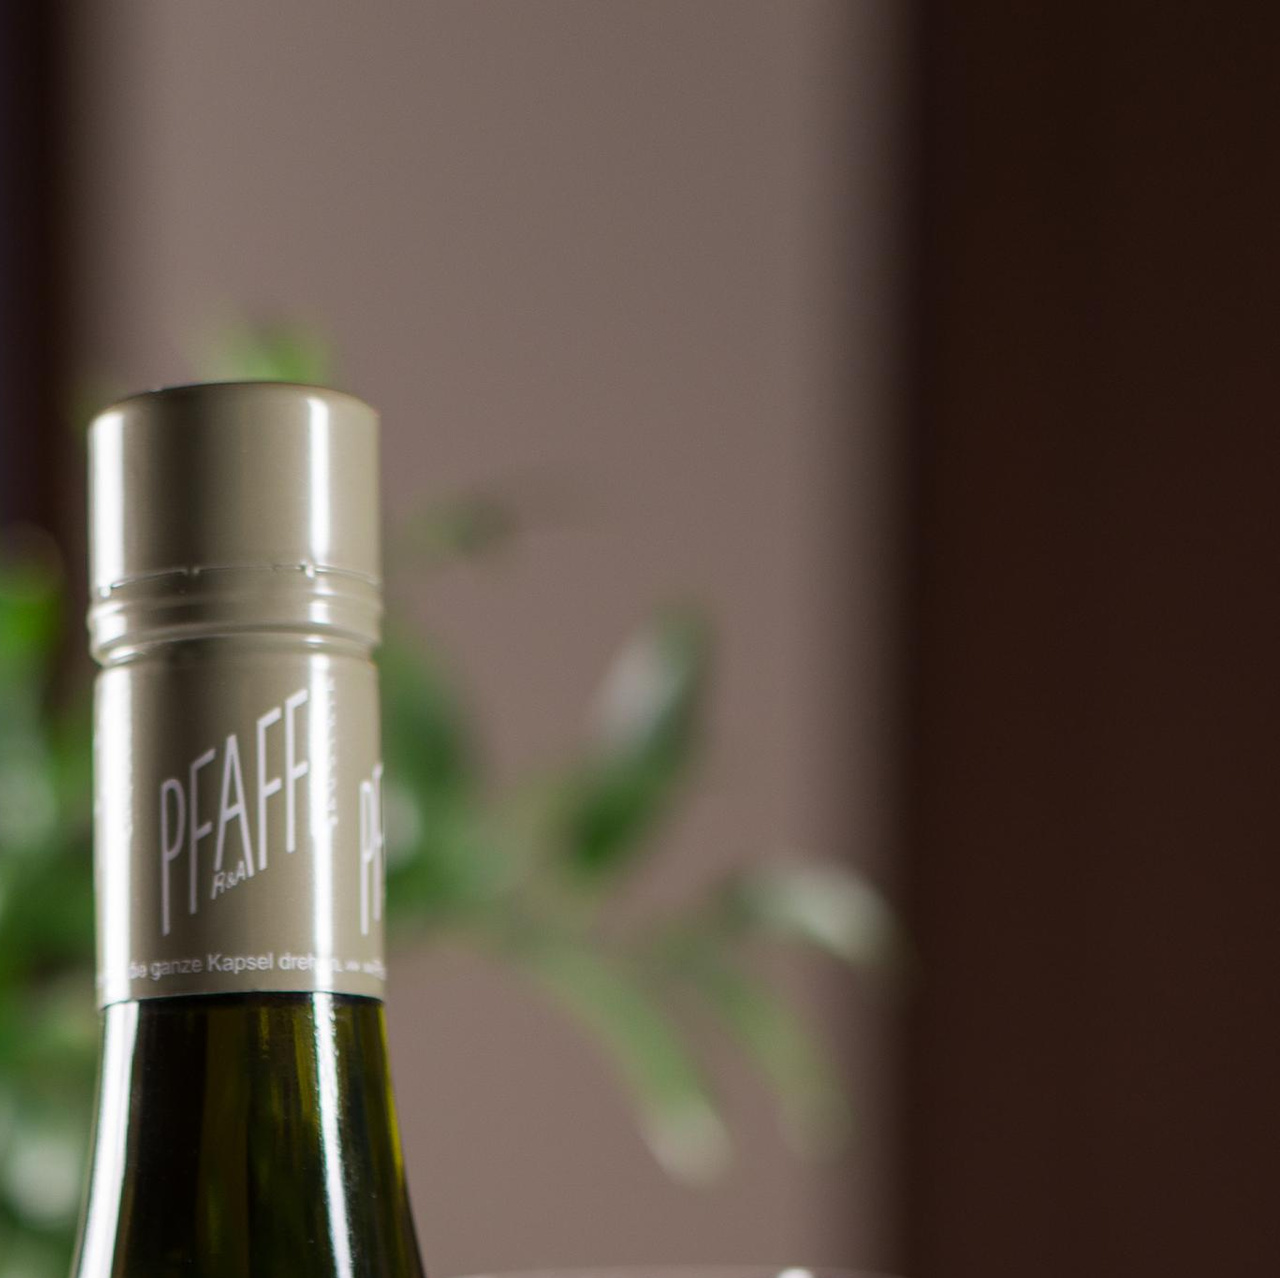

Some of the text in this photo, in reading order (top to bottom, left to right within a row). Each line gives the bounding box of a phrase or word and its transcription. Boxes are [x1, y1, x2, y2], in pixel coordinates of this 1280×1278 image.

[160, 682, 337, 936] PFAFF
[150, 958, 203, 981] ganze
[207, 952, 274, 975] Kapsel
